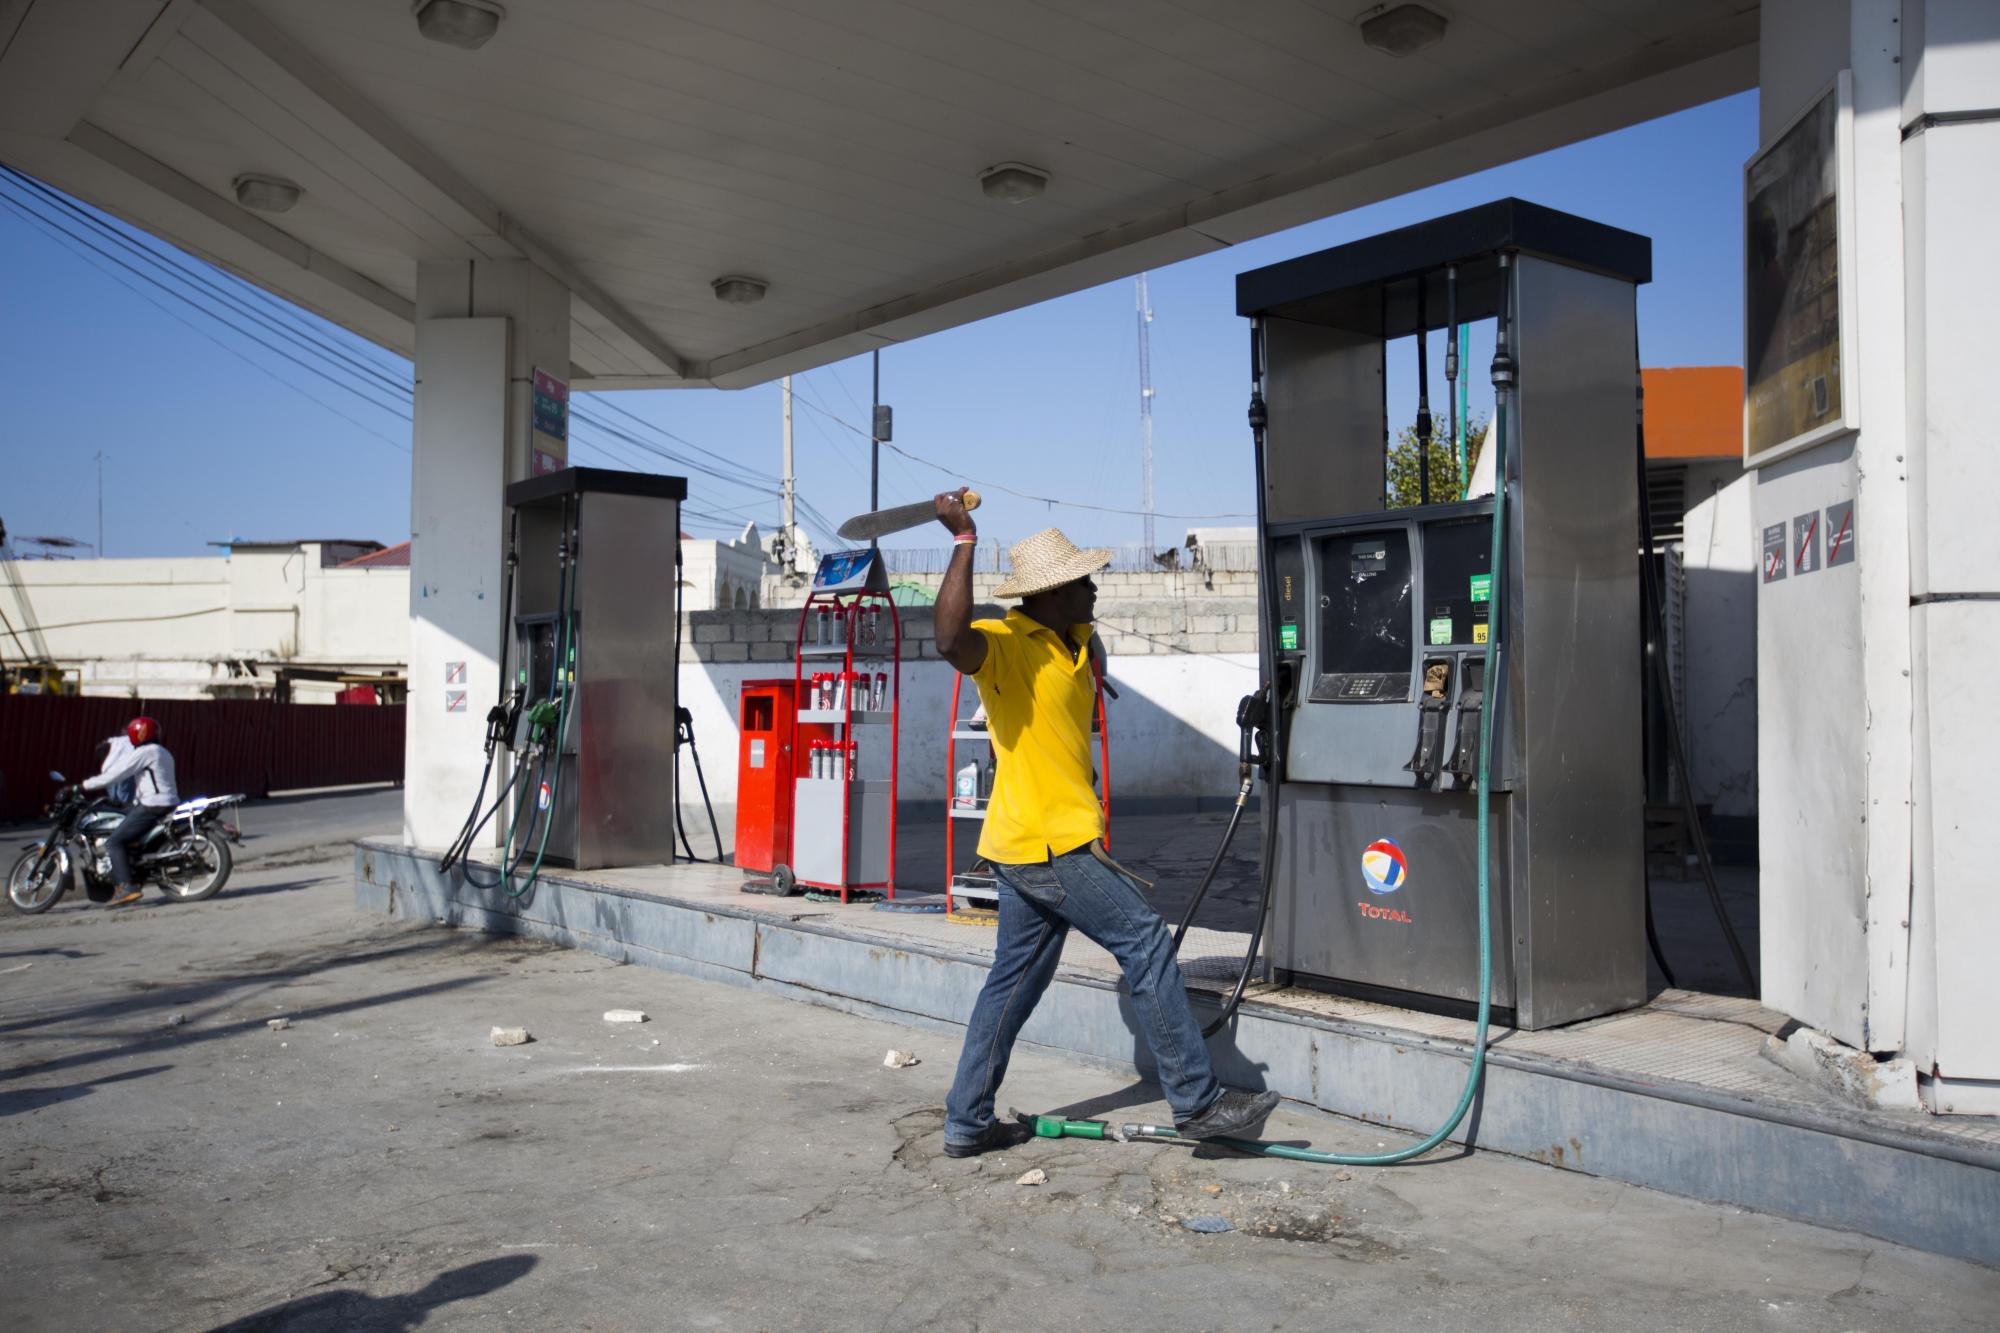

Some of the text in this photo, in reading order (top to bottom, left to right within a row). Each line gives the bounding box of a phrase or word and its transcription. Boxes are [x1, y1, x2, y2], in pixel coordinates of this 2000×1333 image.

[1284, 576, 1292, 601] diesel
[1477, 632, 1487, 642] 95
[1358, 902, 1413, 924] TOTAL
